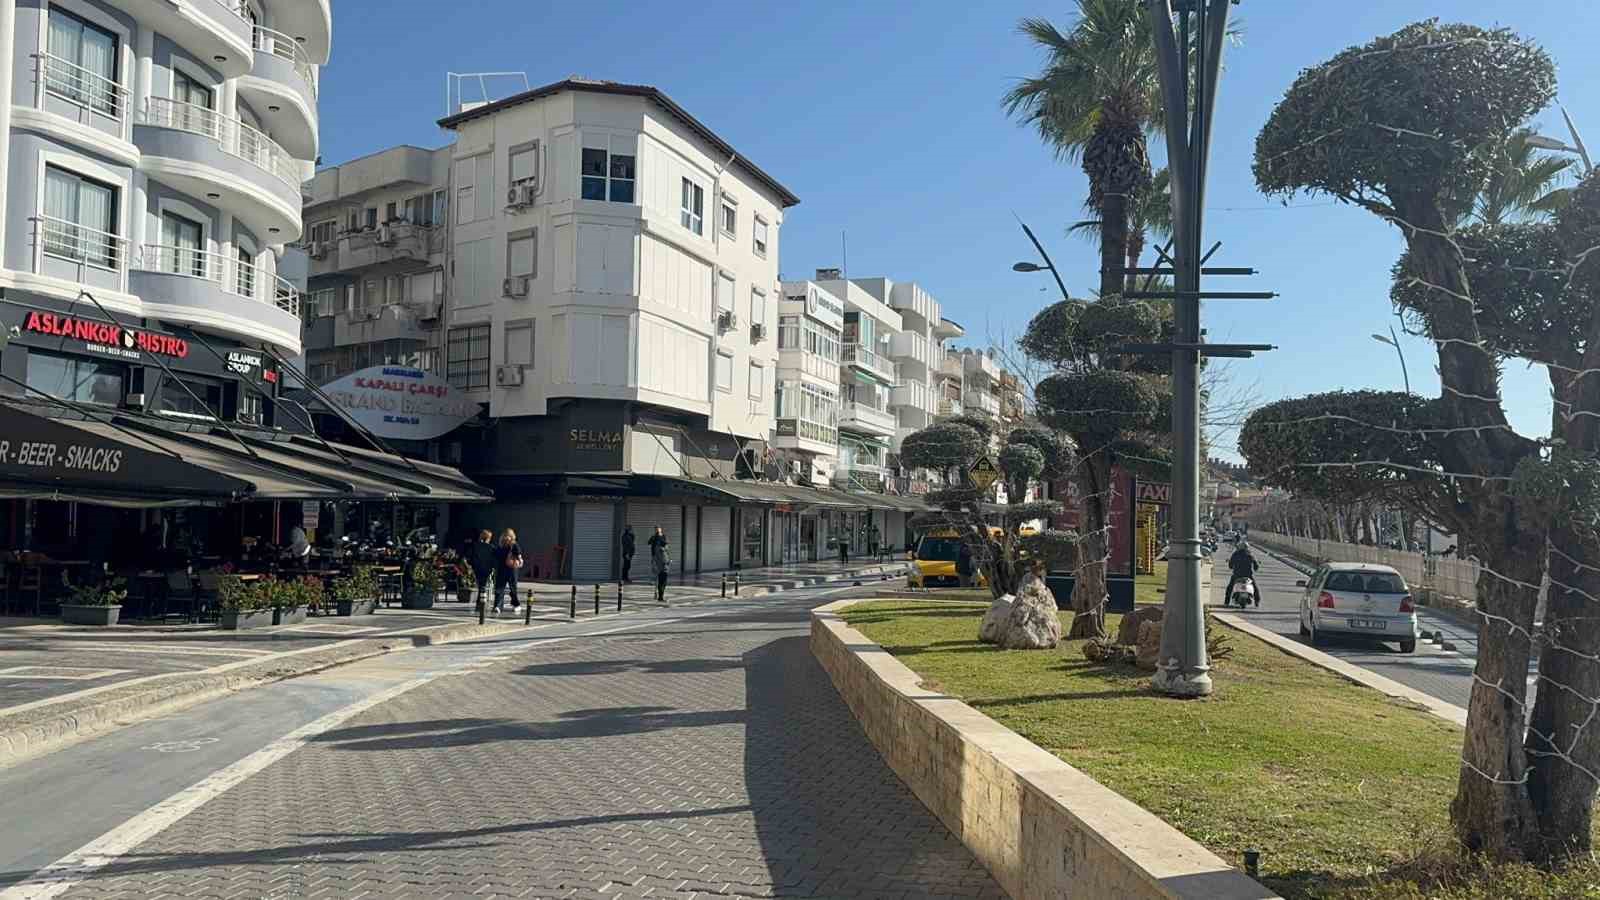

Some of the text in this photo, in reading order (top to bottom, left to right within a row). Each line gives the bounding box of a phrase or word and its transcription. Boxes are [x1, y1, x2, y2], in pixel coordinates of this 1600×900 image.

[137, 333, 189, 358] BISTRO
[353, 377, 449, 399] KAPALI ÇARŞI
[569, 429, 622, 443] SELMA
[18, 441, 57, 467] BEER
[64, 444, 122, 473] SNACKS
[1136, 484, 1169, 500] TAXI
